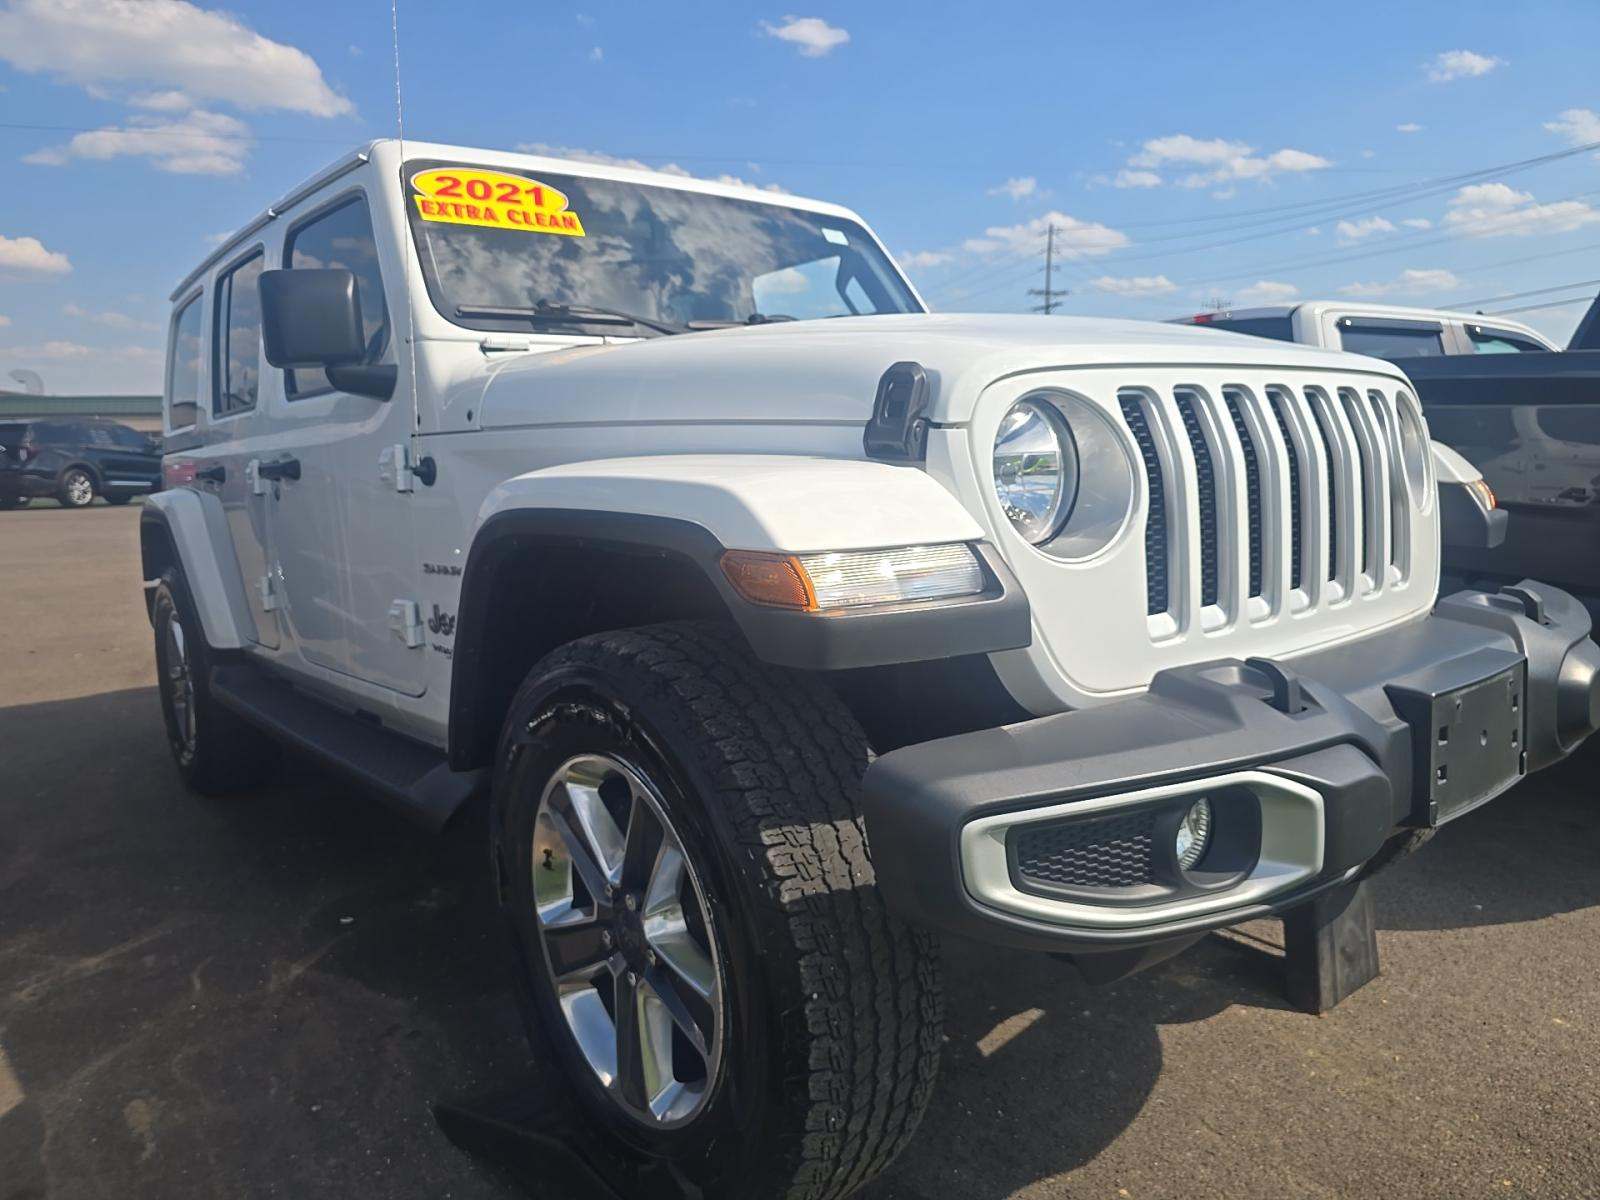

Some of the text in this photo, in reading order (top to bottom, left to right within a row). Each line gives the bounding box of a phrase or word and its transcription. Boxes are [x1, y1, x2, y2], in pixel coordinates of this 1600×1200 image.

[434, 176, 545, 208] 2021
[420, 199, 578, 232] EXTRA CLEAN
